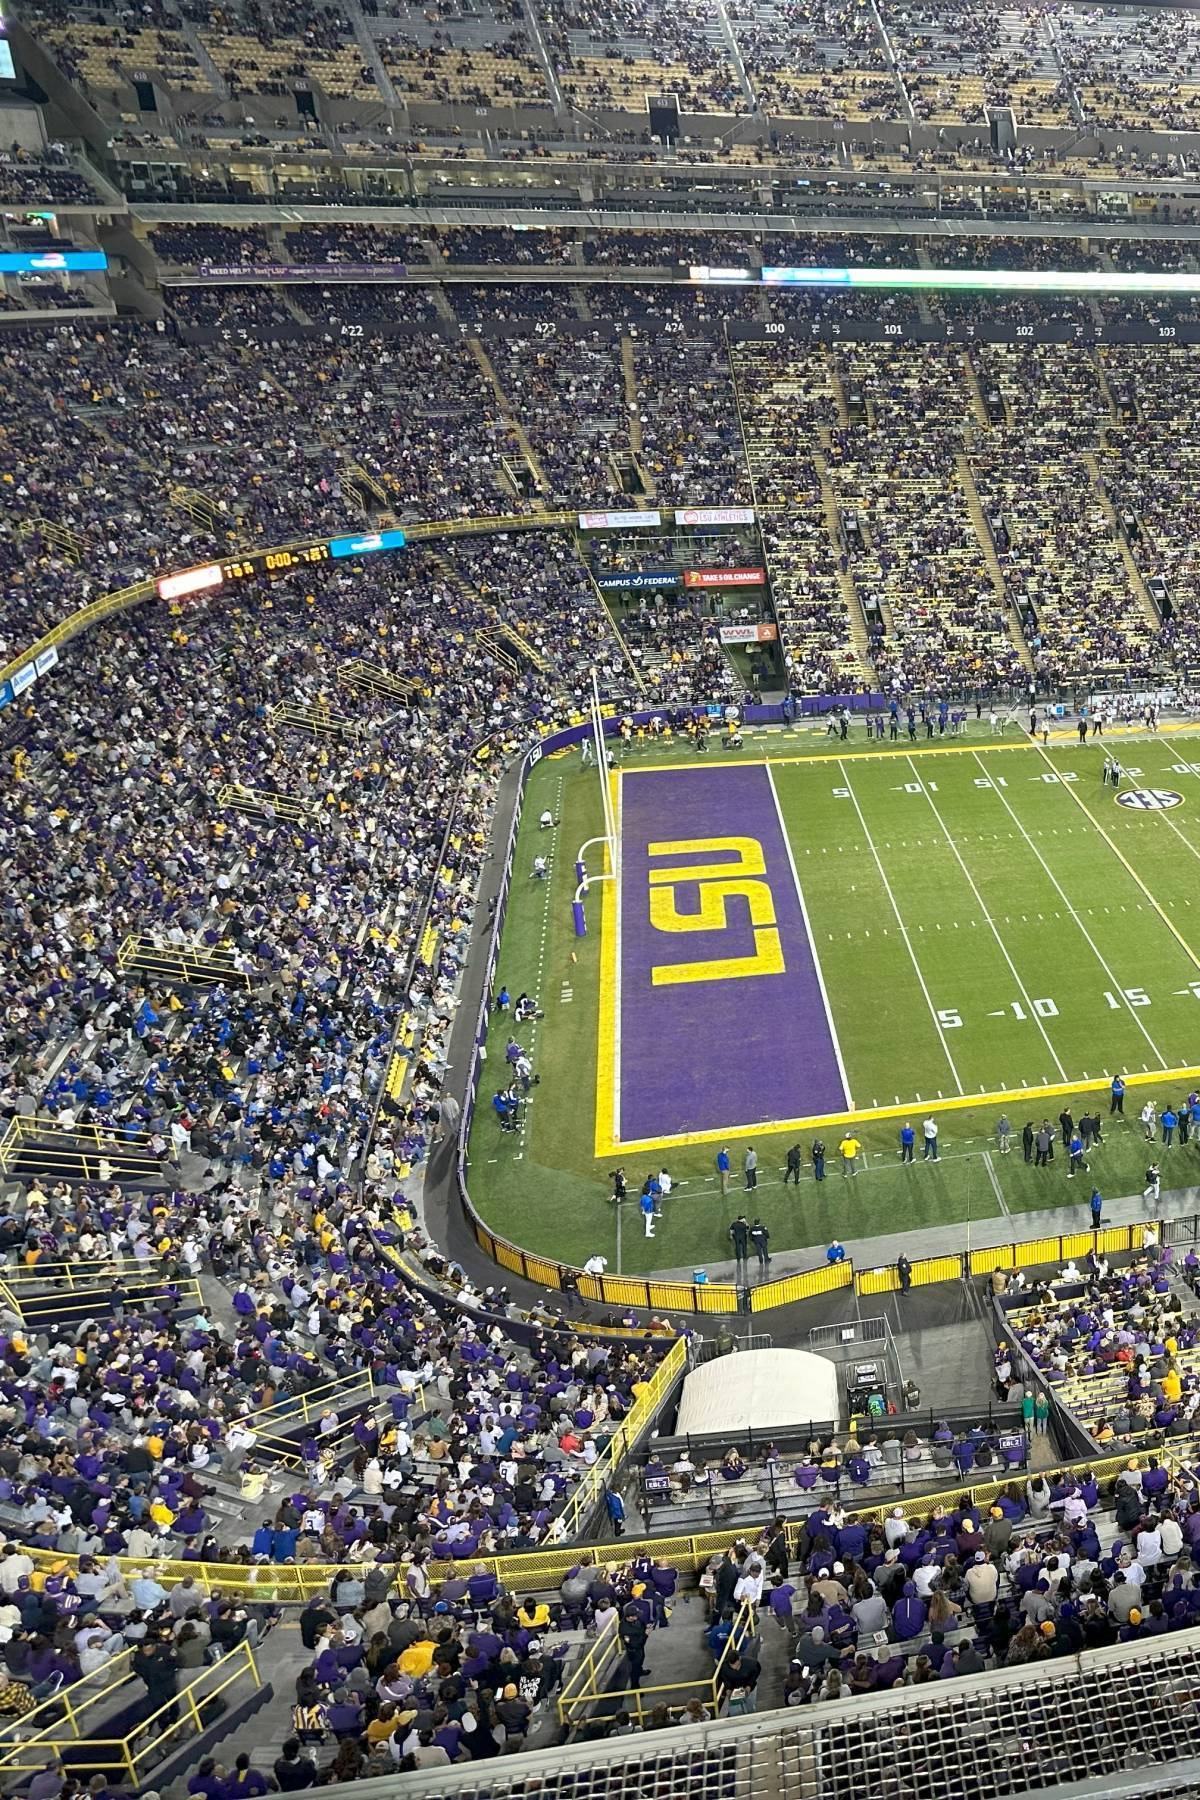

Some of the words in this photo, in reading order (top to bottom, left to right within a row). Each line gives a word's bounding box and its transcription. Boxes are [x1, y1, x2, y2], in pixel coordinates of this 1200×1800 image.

[341, 325, 364, 336] 422
[765, 323, 785, 333] 100
[884, 324, 903, 335] 101
[1016, 326, 1034, 336] 102
[1158, 327, 1176, 337] 103
[713, 511, 748, 521] ATHLETICS
[266, 552, 291, 570] 0:00
[723, 573, 734, 581] OIL
[734, 572, 760, 581] CHANGE
[598, 579, 631, 588] CAMPUS
[644, 577, 676, 585] FEDERAL
[529, 745, 542, 767] LSU
[973, 777, 1009, 789] 15
[1039, 772, 1080, 784] 20
[832, 788, 851, 799] 5
[904, 782, 938, 794] 10
[647, 836, 786, 986] LSU
[1102, 987, 1152, 1009] 15
[1009, 998, 1060, 1020] 10
[937, 1008, 963, 1028] 5
[501, 1468, 509, 1479] 9
[306, 1520, 314, 1530] 3
[641, 1563, 649, 1573] 7
